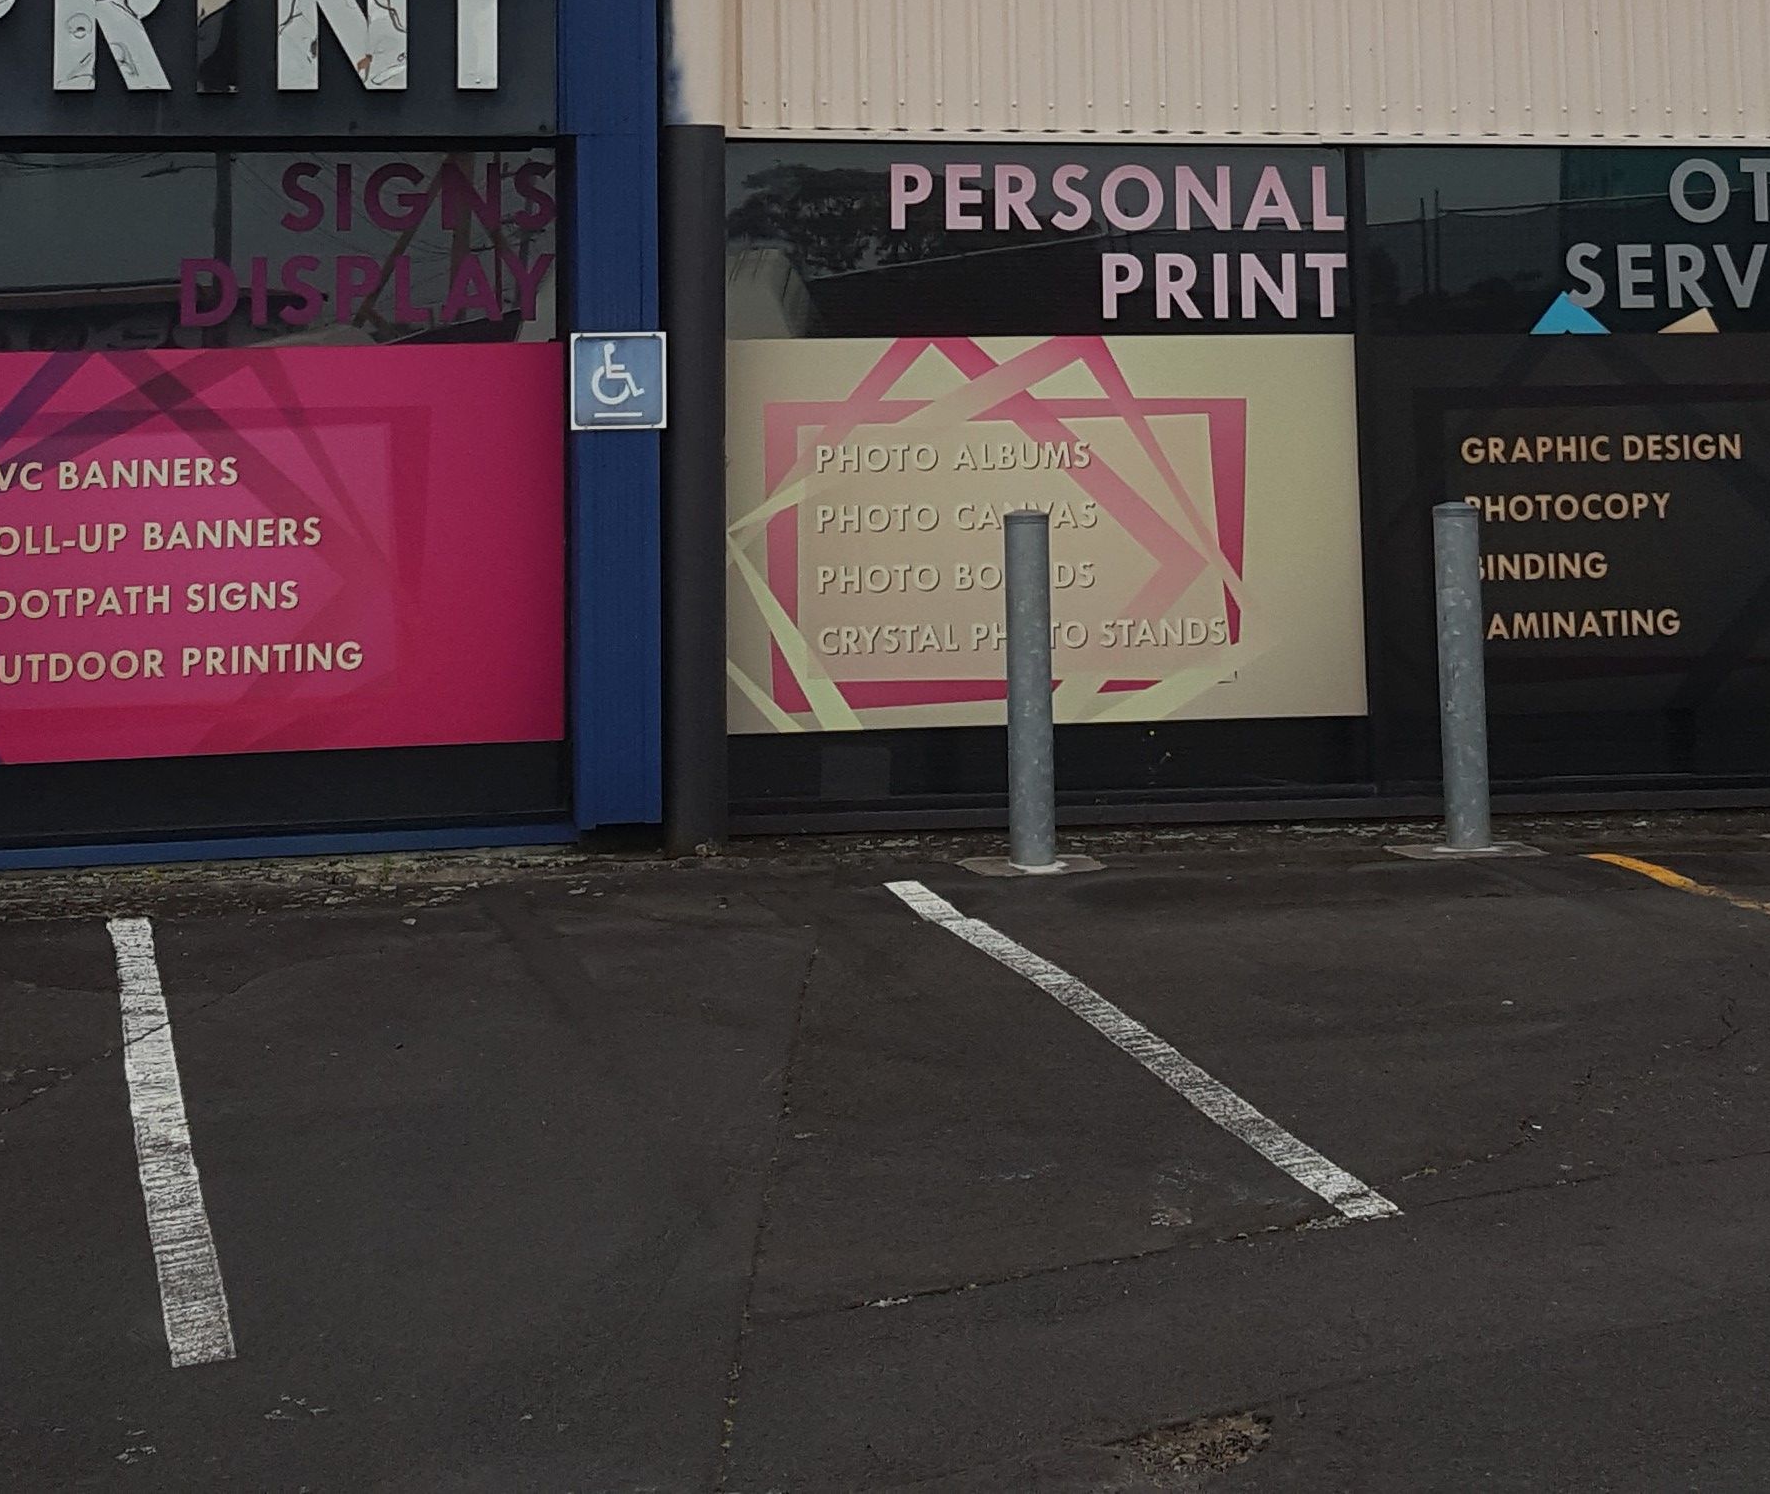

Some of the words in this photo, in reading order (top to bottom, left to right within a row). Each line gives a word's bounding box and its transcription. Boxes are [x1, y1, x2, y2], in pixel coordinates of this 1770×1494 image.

[280, 162, 558, 233] SIGNS
[889, 162, 1346, 232] PERSONAL
[178, 253, 557, 329] DISPLAY
[1100, 252, 1347, 319] PRINT
[815, 443, 939, 473] PHOTO
[952, 441, 1092, 470] ALBUMS
[1460, 434, 1612, 465] GRAPHIC
[1622, 433, 1743, 461] DESIGN
[58, 457, 240, 490] BANNERS
[142, 517, 323, 552] BANNERS
[815, 503, 940, 534] PHOTO
[815, 564, 941, 595] PHOTO
[952, 561, 1096, 591] BODS
[1478, 551, 1608, 582] INDING
[184, 579, 300, 614] SIGNS
[818, 623, 960, 656] CRYSTAL
[970, 619, 1089, 652] PHTO
[1099, 616, 1228, 650] STANDS
[1483, 609, 1681, 641] AMINATING
[181, 640, 365, 678] PRINTING
